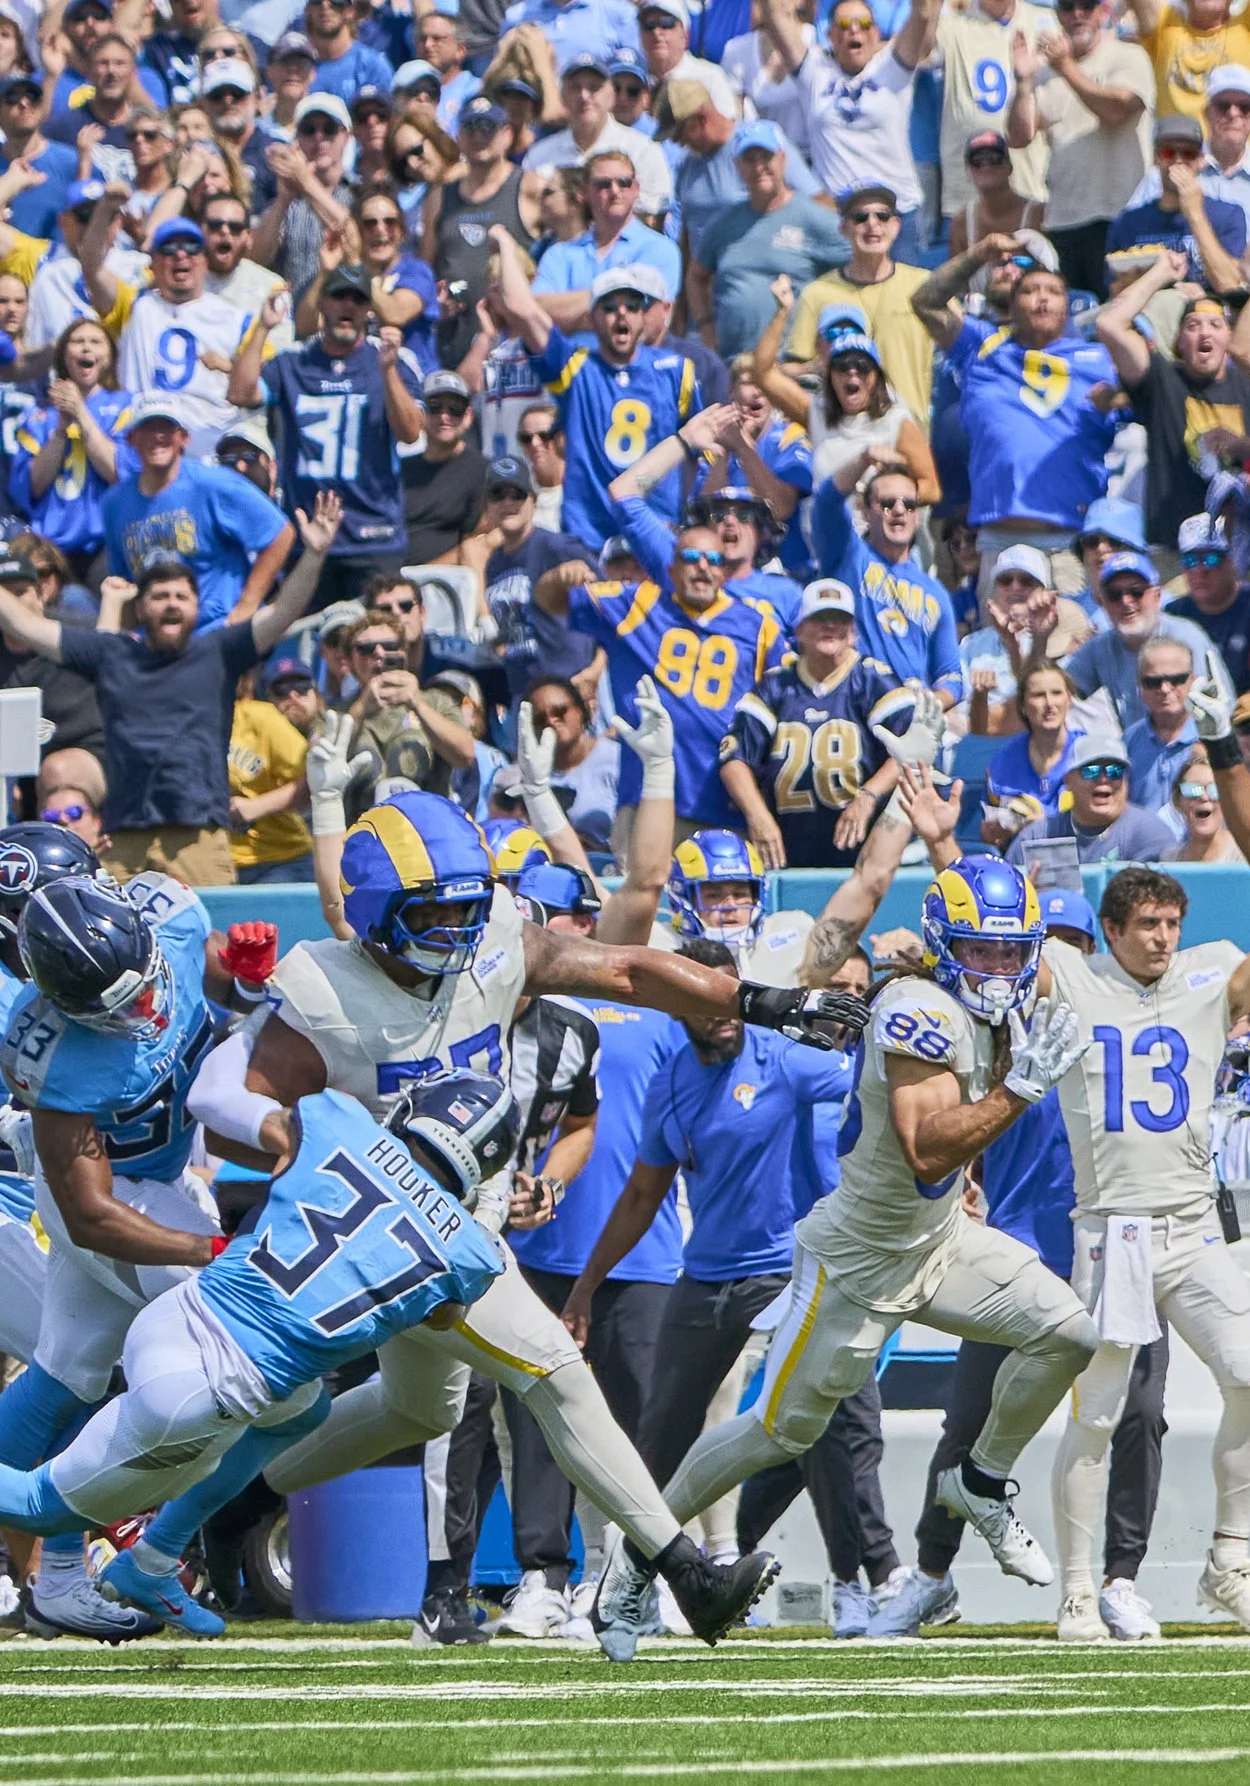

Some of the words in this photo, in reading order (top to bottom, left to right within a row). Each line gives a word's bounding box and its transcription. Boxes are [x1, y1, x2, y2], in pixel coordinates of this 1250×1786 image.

[974, 58, 1008, 114] 9
[155, 327, 197, 392] 9
[1019, 349, 1069, 419] 9
[296, 394, 367, 480] 31
[604, 398, 651, 469] 8
[654, 627, 739, 711] 88
[771, 717, 865, 815] 28
[6, 1011, 53, 1062] 33
[886, 1012, 950, 1059] 88
[1093, 1023, 1191, 1133] 13
[433, 1127, 476, 1179] TENNESSEE
[362, 1136, 465, 1244] HOOKER
[242, 1145, 452, 1338] 37
